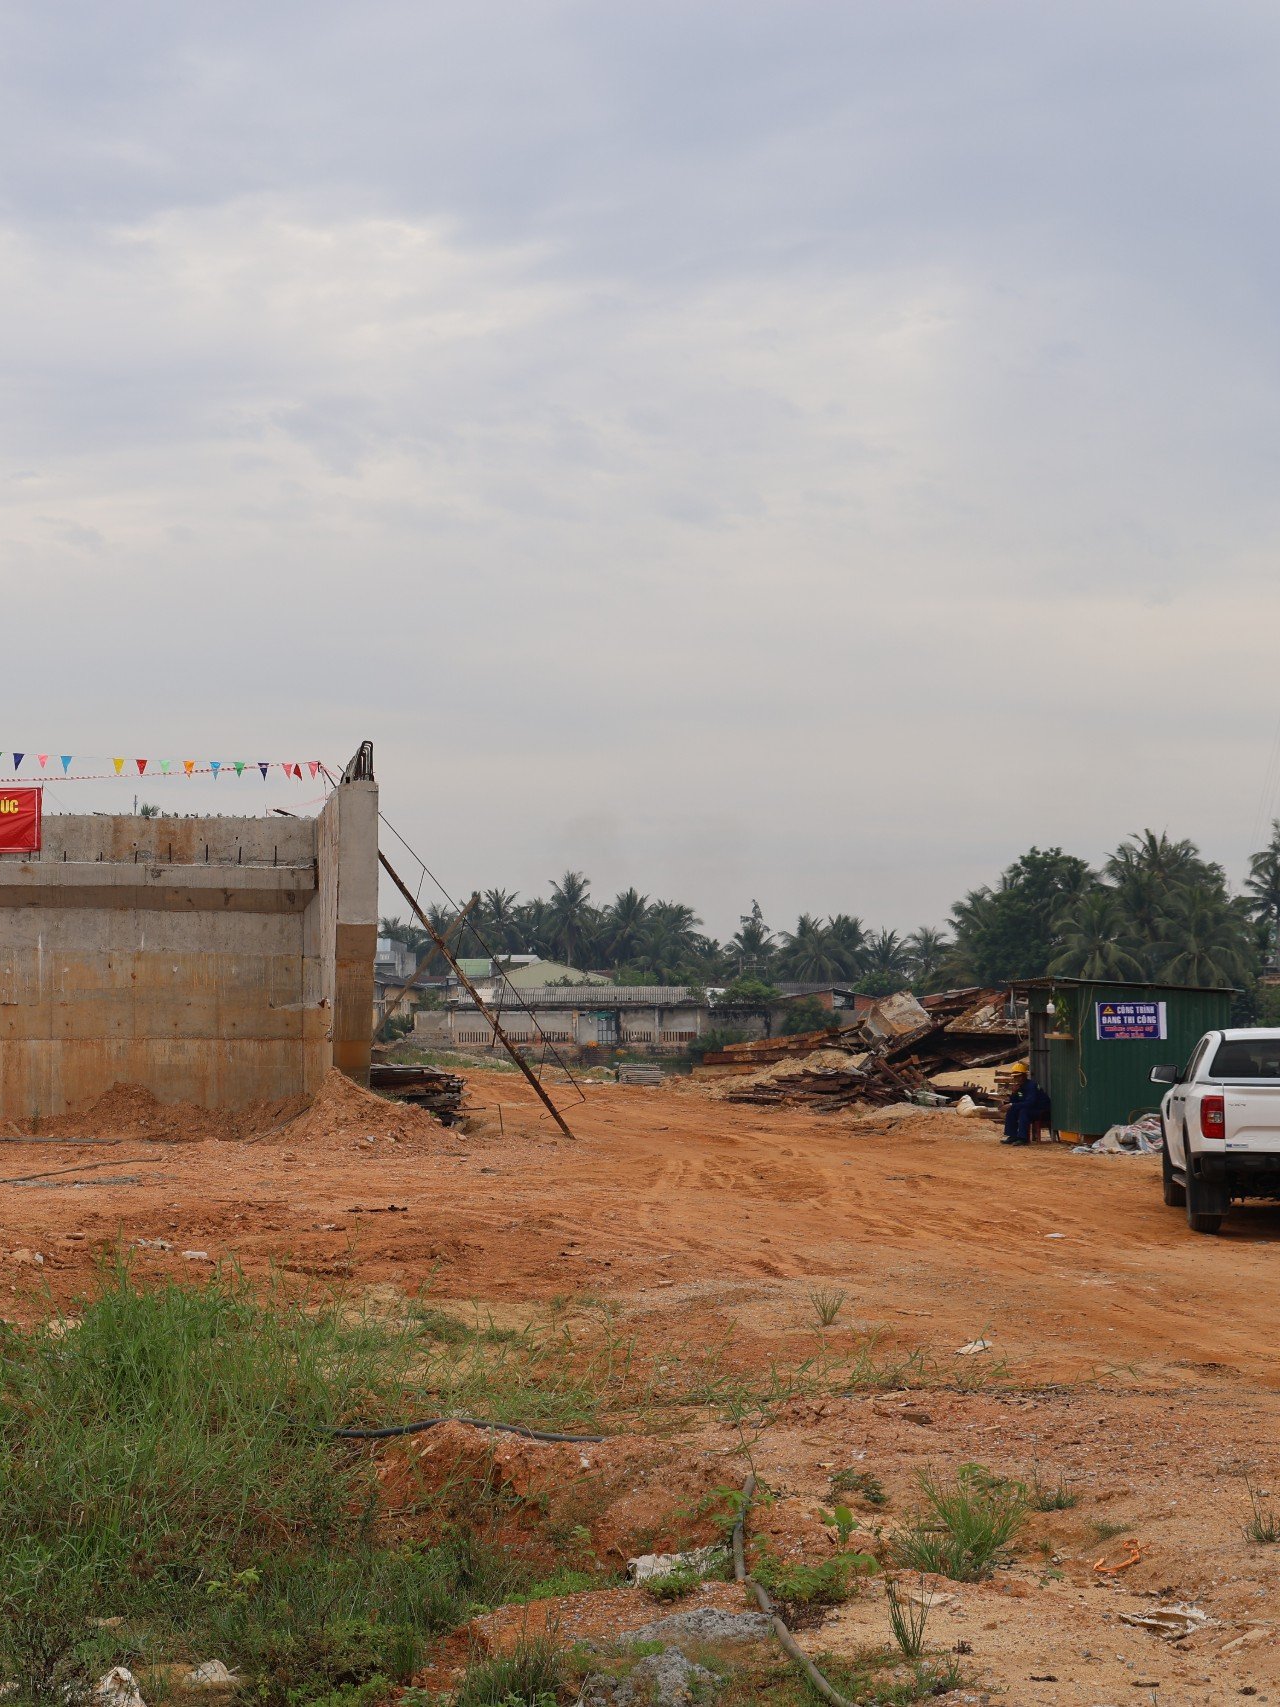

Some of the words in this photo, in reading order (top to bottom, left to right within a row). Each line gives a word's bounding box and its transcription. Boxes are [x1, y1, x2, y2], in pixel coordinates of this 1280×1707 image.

[1117, 1005, 1134, 1014] CÔNG
[1123, 1016, 1135, 1024] THI
[1137, 1015, 1156, 1024] CÔNG
